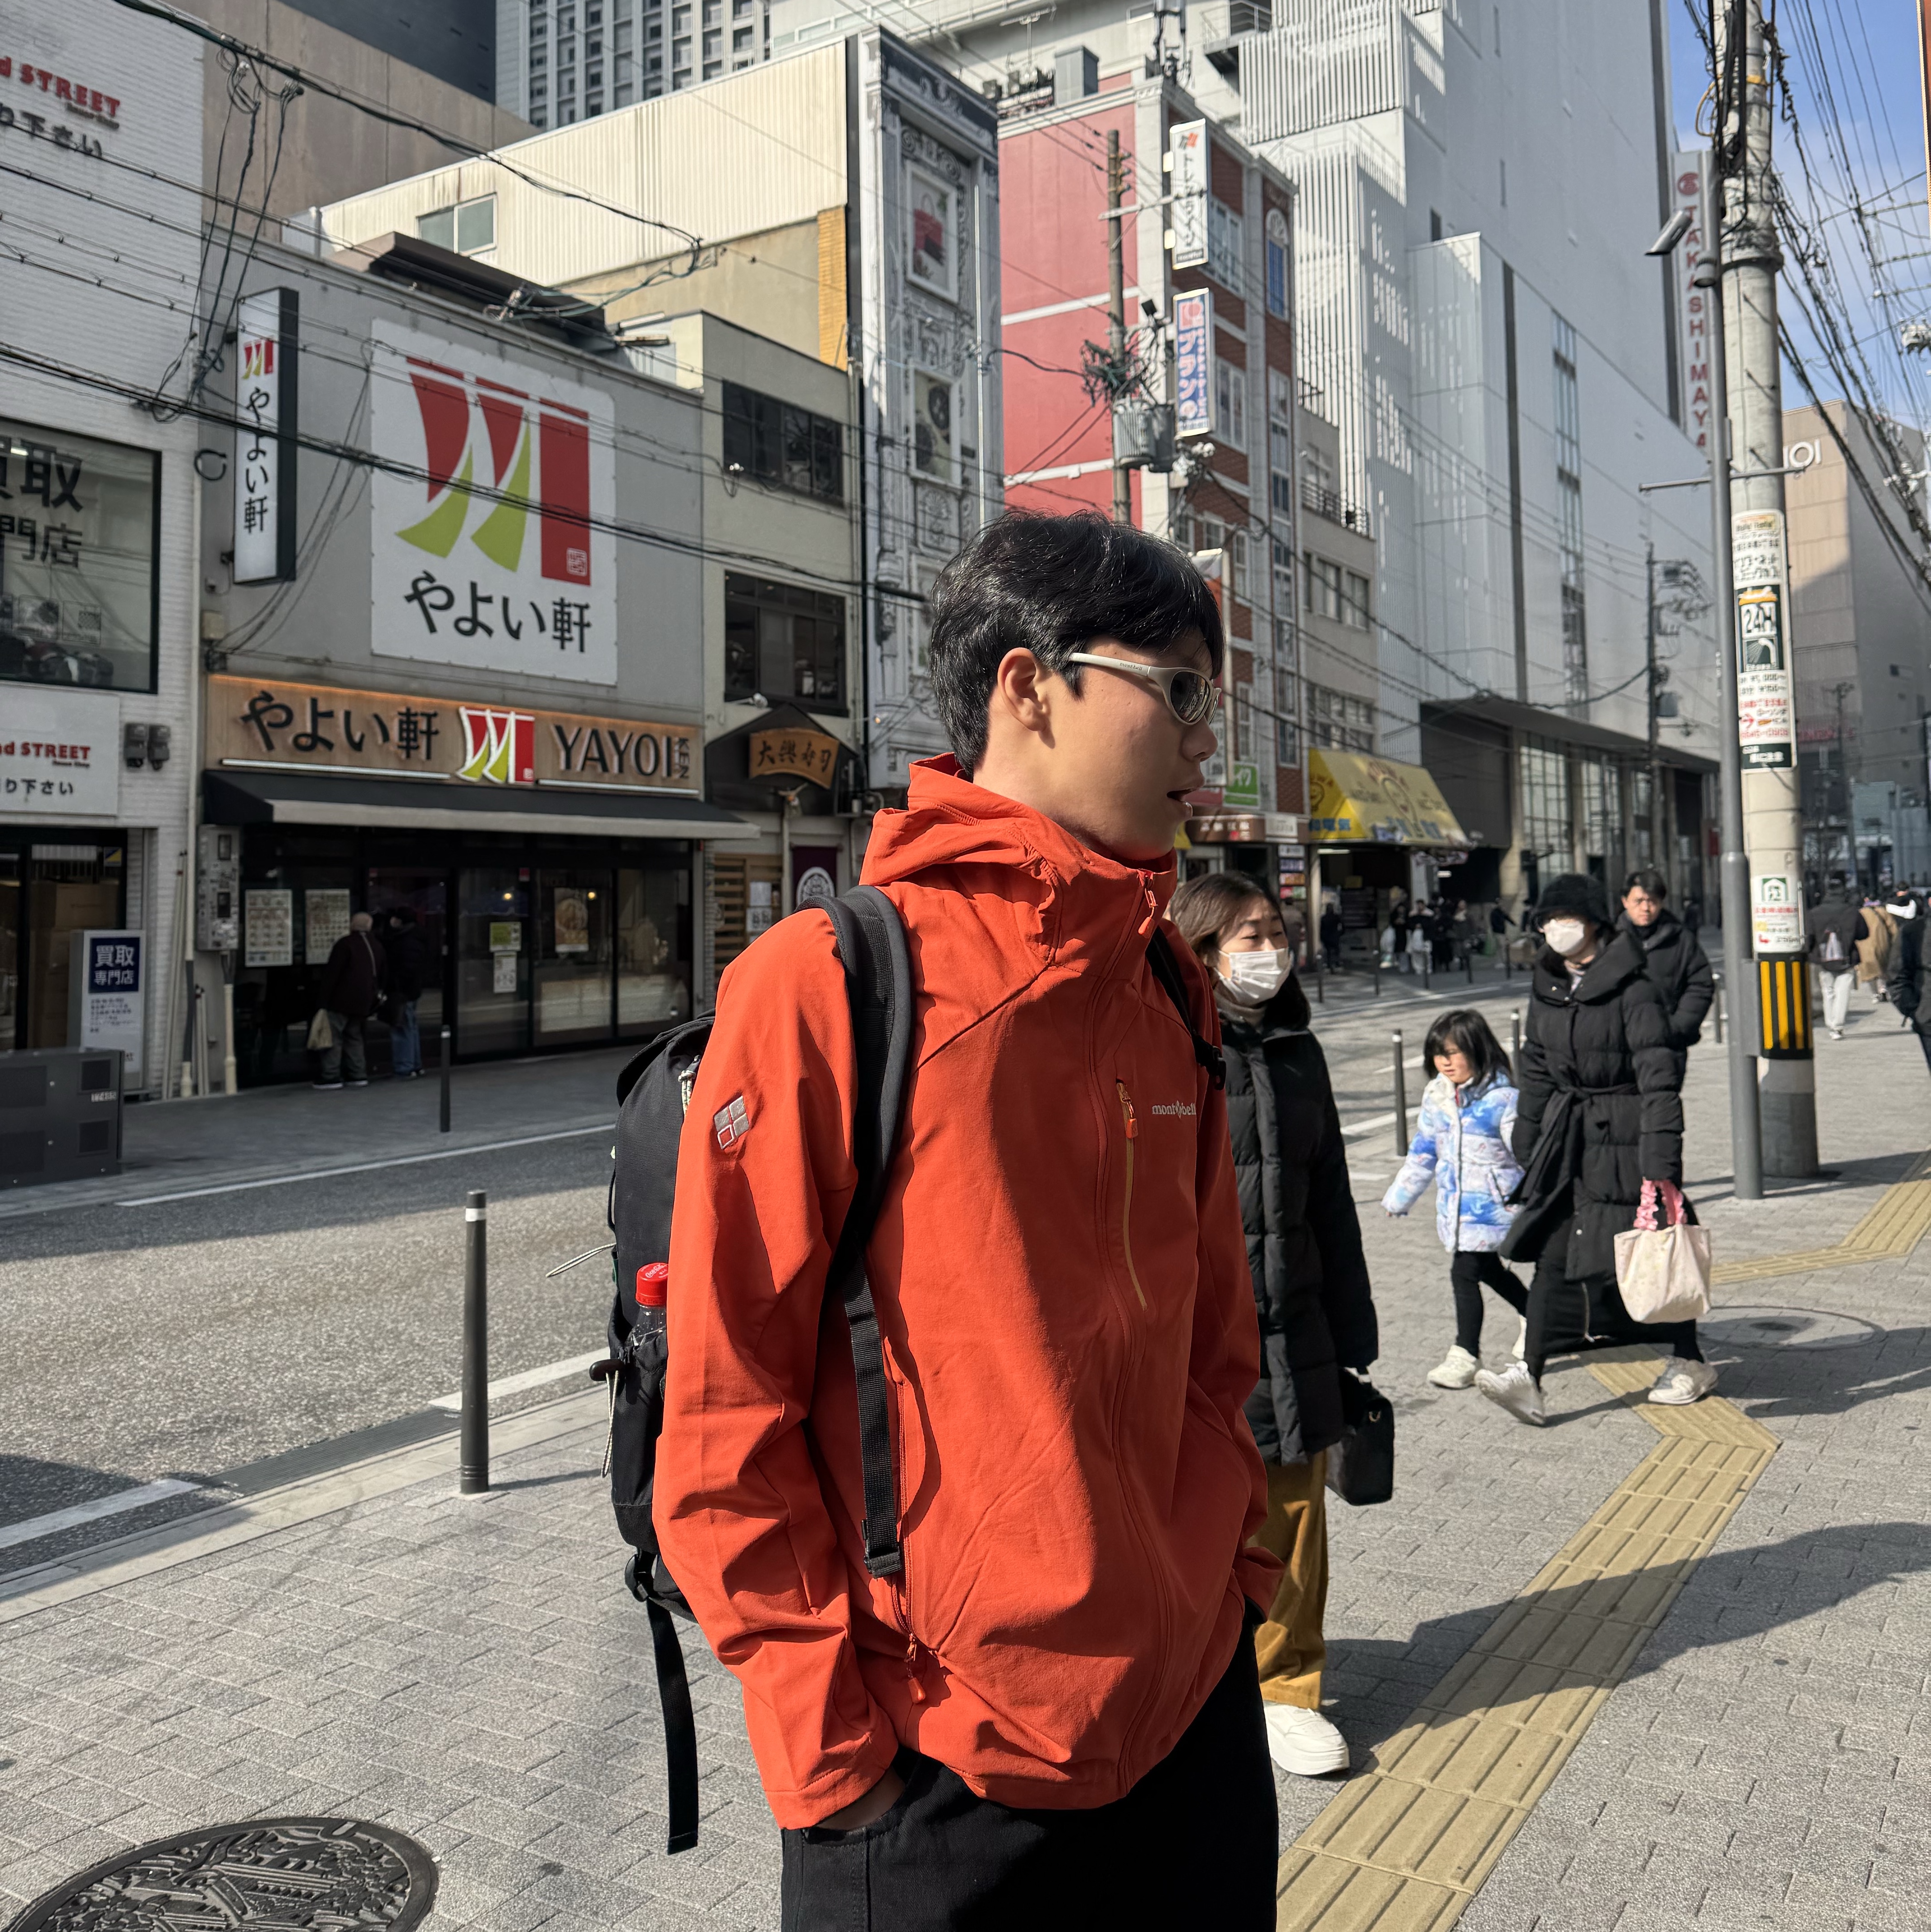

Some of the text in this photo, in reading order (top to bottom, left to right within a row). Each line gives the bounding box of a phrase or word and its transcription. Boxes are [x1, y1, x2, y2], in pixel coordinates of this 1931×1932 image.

[20, 63, 120, 118] STREET
[0, 436, 83, 512] 取
[243, 387, 270, 534] やよい軒
[404, 570, 592, 653] やよい軒
[21, 742, 90, 760] STREET
[240, 690, 440, 761] やよい軒
[551, 724, 672, 779] YAYOI
[676, 737, 690, 779] KEN
[94, 969, 134, 986] 専門店
[95, 945, 135, 968] 買取
